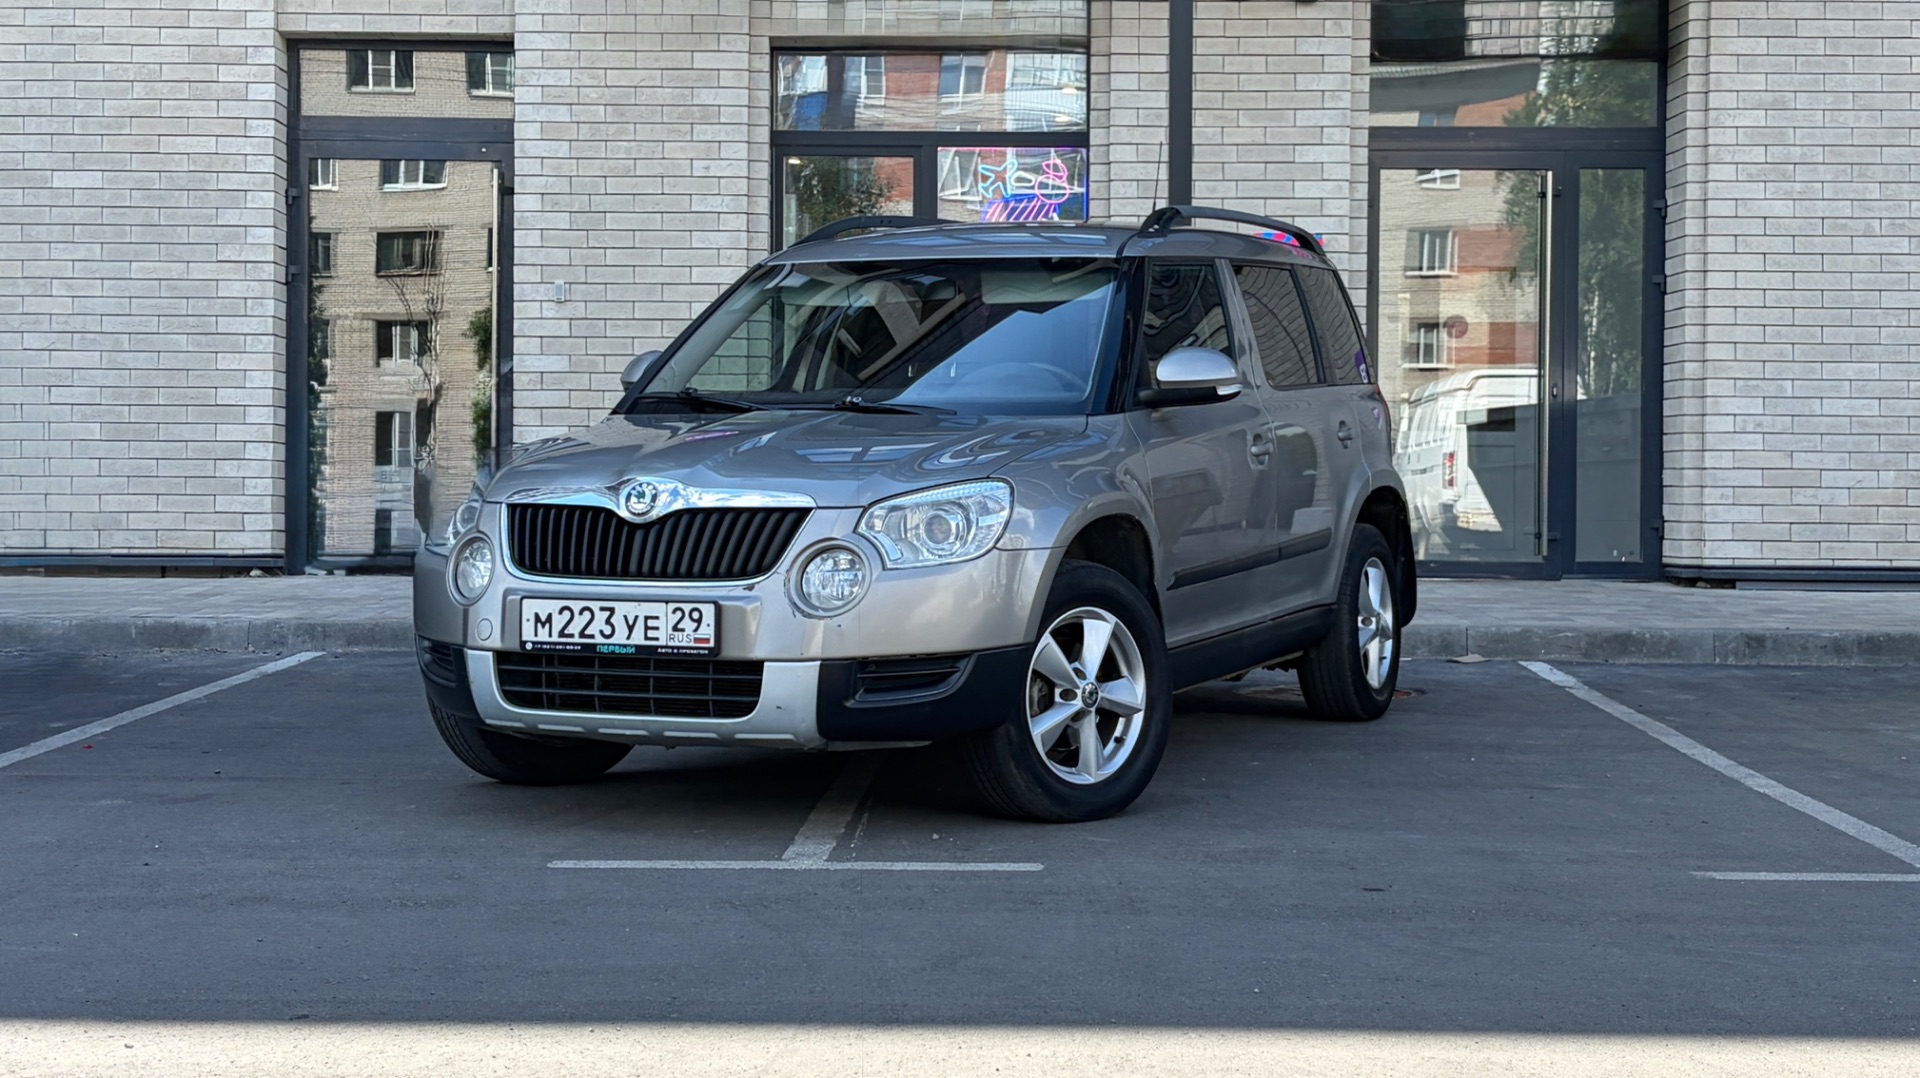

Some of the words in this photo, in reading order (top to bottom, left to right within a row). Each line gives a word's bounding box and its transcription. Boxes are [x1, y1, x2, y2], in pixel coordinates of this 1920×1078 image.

[534, 605, 660, 641] М223УЕ
[671, 606, 704, 633] 29
[669, 634, 692, 643] RUS
[597, 644, 636, 654] ПЕРВЫЙ
